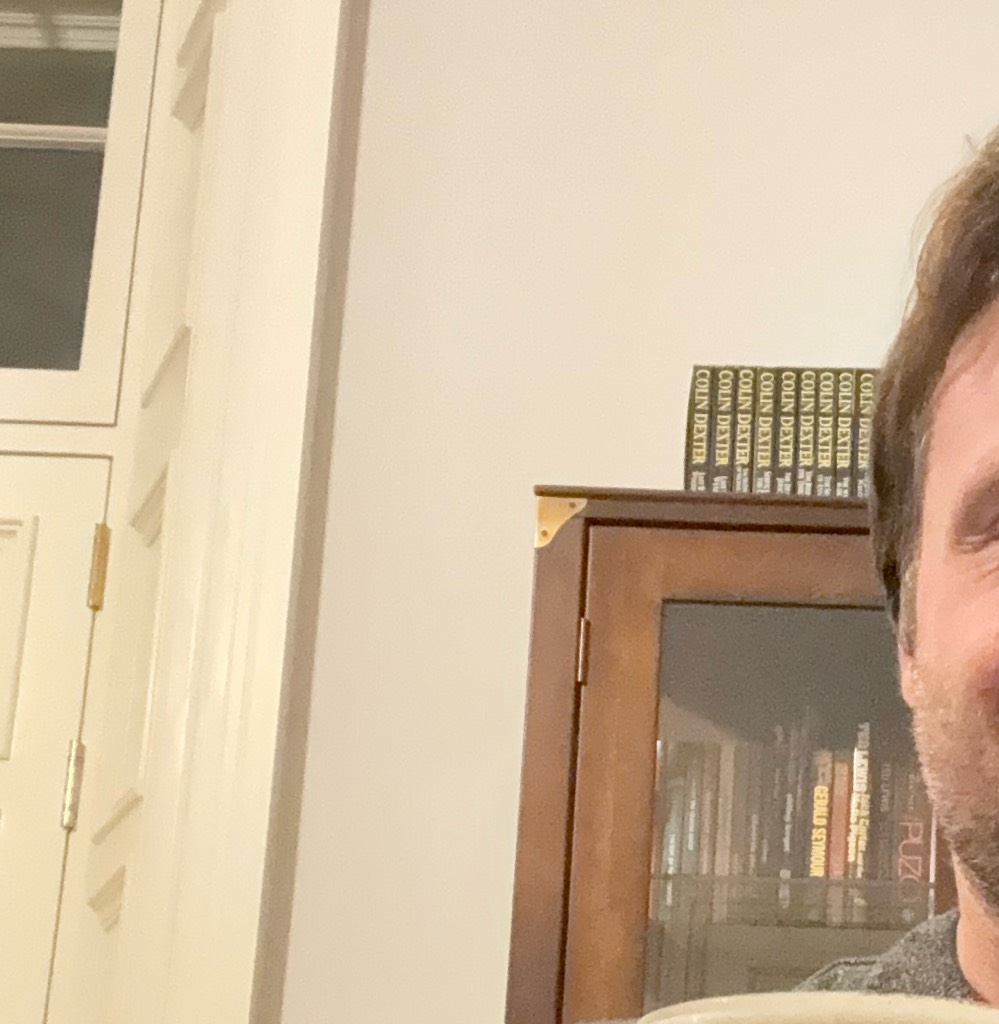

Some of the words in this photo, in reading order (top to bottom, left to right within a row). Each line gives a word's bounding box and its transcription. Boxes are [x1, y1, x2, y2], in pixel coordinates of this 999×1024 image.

[695, 369, 710, 410] COLIN
[718, 370, 733, 411] COLIN
[738, 369, 754, 410] COLIN
[760, 372, 774, 413] COLIN
[781, 371, 796, 413] COLIN
[801, 370, 816, 413] COLIN
[819, 371, 834, 413] COLIN
[838, 372, 853, 414] COLIN
[692, 413, 708, 464] DEXTER
[715, 414, 731, 466] DEXTER
[736, 413, 751, 465] DEXTER
[757, 416, 773, 468] DEXTER
[779, 416, 794, 467] DEXTER
[799, 415, 814, 466] DEXTER
[817, 416, 833, 468] DEXTER
[836, 416, 852, 468] DEXTER
[813, 785, 829, 826] GERALD
[809, 827, 827, 877] SEYMOUR
